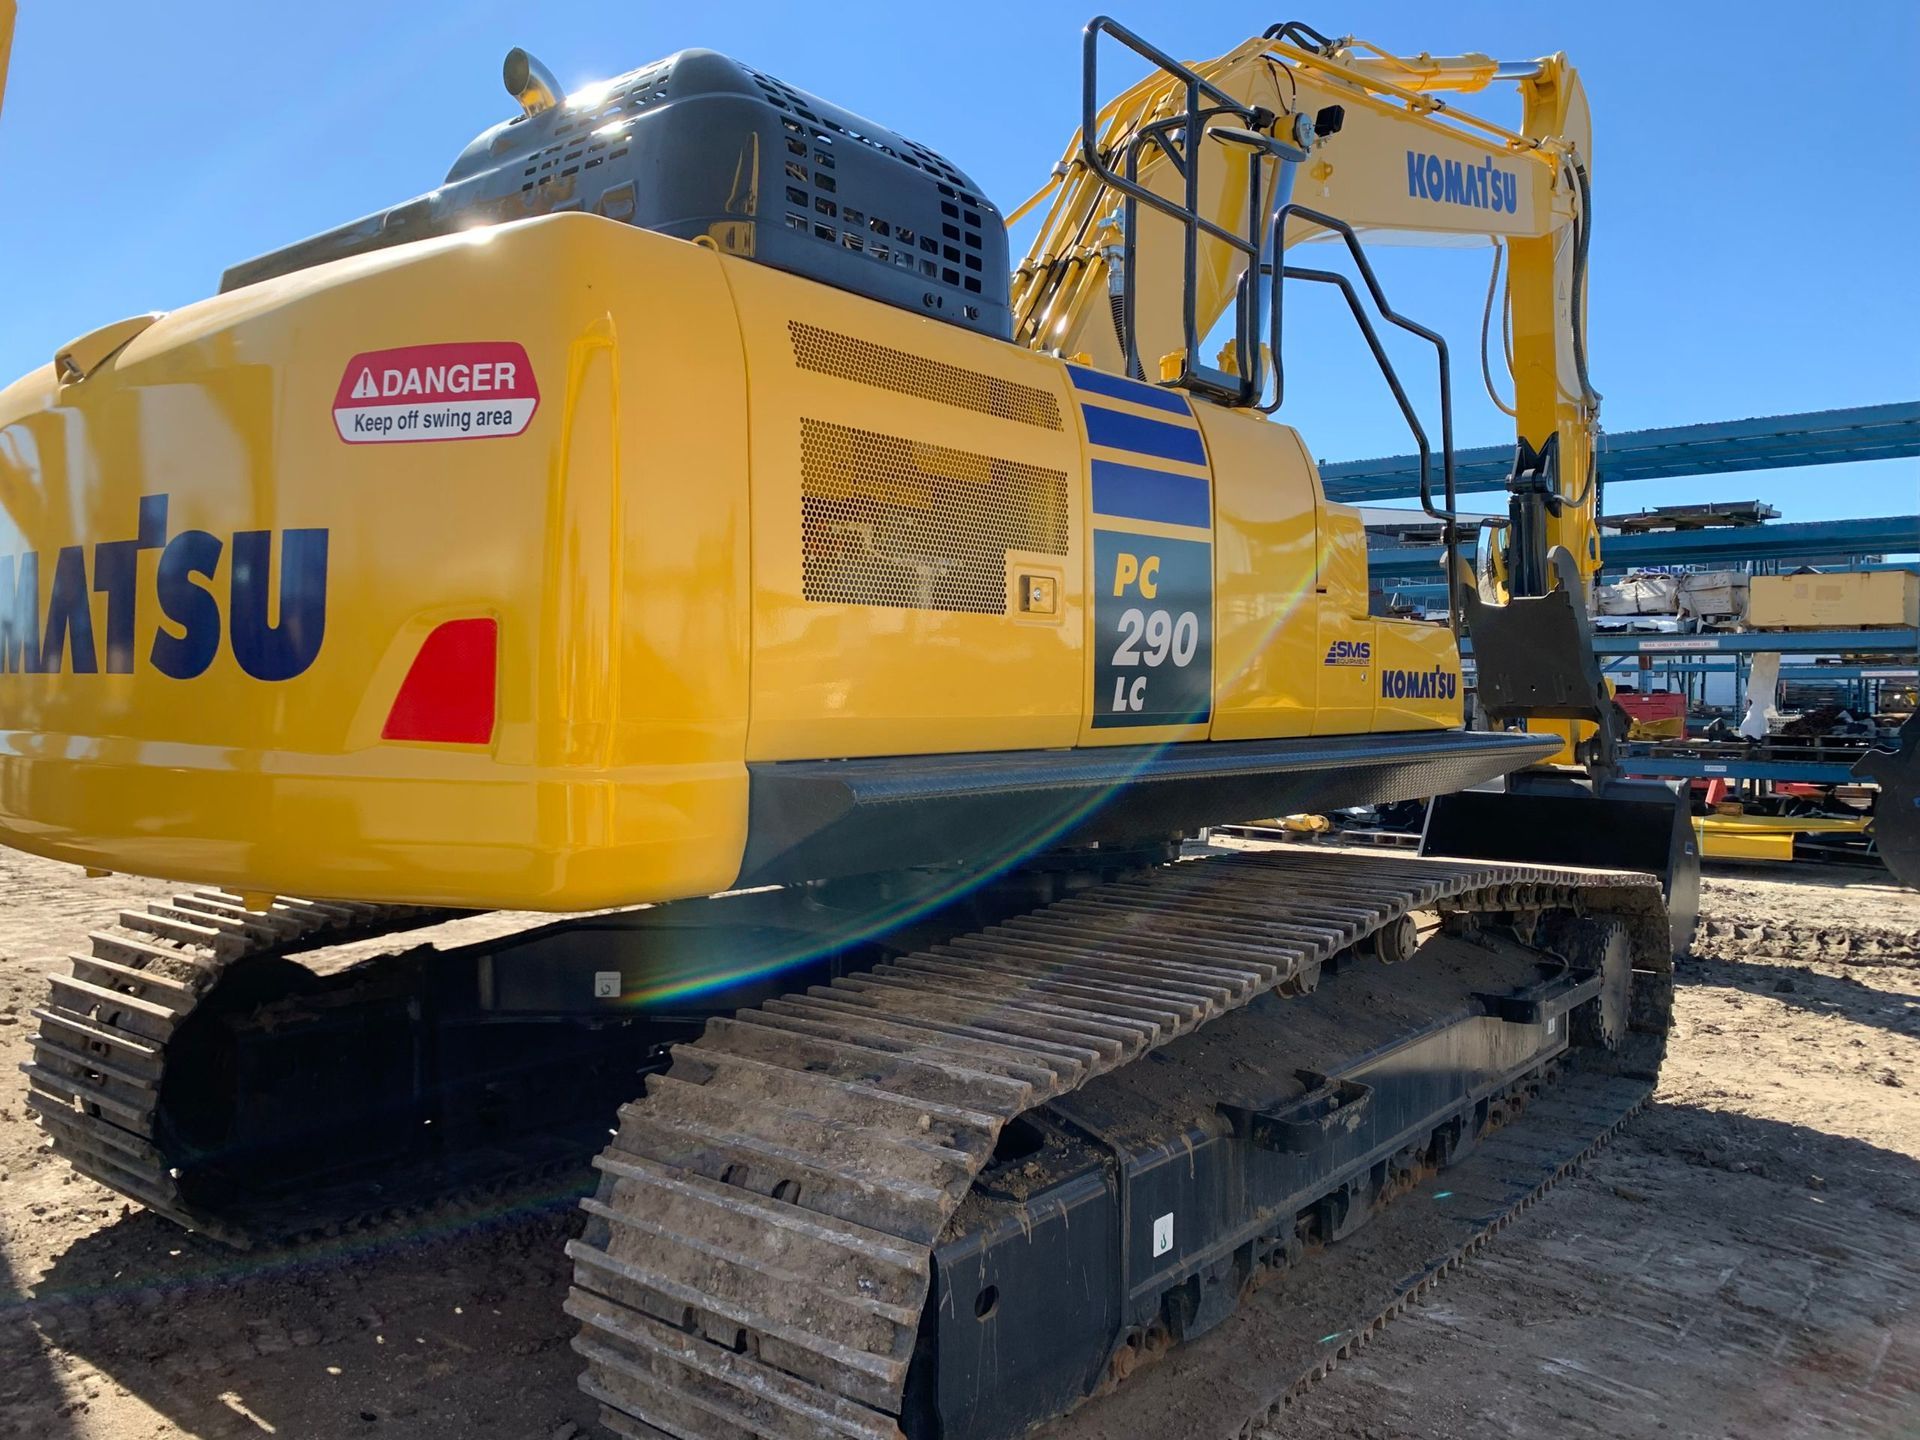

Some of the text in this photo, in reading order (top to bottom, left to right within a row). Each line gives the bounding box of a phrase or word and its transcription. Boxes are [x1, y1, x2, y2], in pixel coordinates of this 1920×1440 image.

[1407, 150, 1517, 214] KOMATSU
[382, 362, 516, 397] DANGER
[354, 408, 513, 435] Keep off swing area
[1113, 553, 1160, 599] PC
[1112, 608, 1199, 668] 290
[1336, 641, 1371, 659] SMS
[1112, 676, 1148, 712] LC
[1382, 664, 1456, 700] KOMATSU
